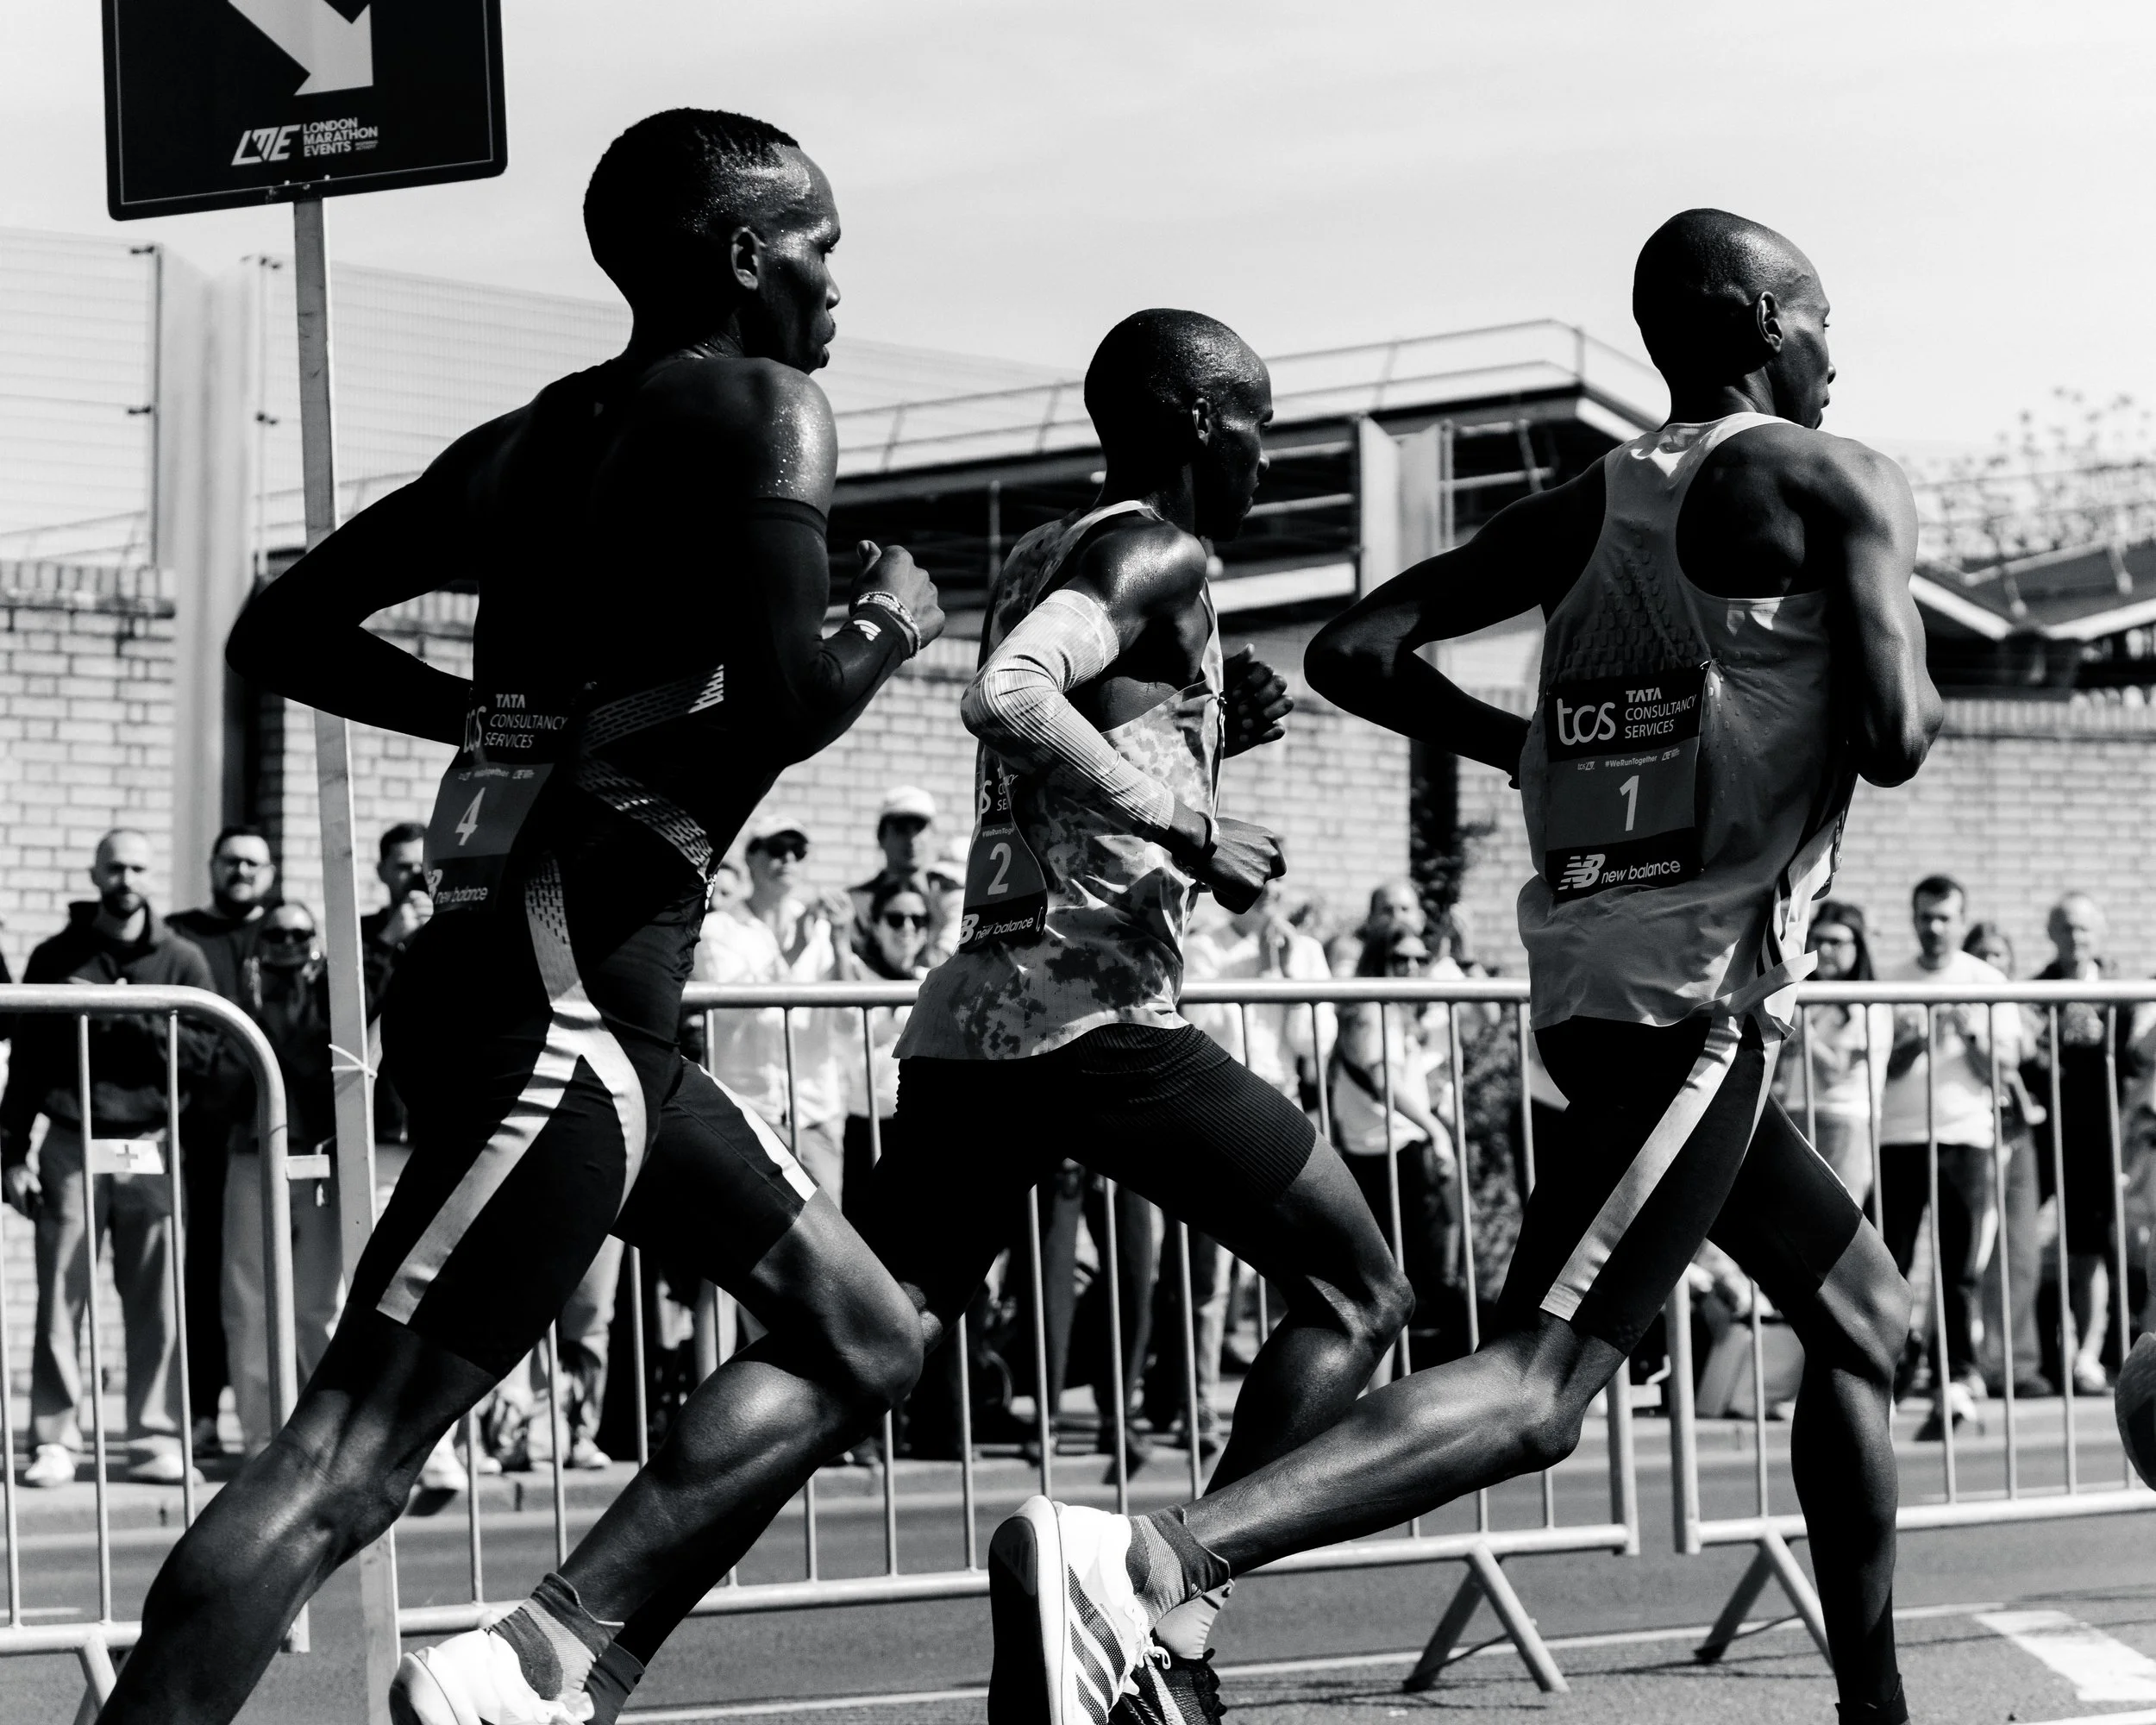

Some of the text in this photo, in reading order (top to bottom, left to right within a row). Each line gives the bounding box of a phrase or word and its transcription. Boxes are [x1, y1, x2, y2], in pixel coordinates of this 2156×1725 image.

[303, 116, 358, 135] LONDON
[304, 127, 379, 144] MARATHON
[304, 141, 351, 157] EVENTS
[495, 693, 526, 708] TATA
[1626, 687, 1663, 703] TATA
[1625, 694, 1697, 721] CONSULTANCY
[490, 713, 569, 731] CONSULTANCY
[1557, 698, 1616, 746] tcs
[1625, 718, 1674, 739] SERVICES
[484, 731, 535, 749] SERVICES
[1605, 755, 1658, 768] #WeRunTogether
[1619, 775, 1639, 831] 1
[454, 787, 486, 846] 4
[987, 842, 1012, 896] 2
[1601, 868, 1627, 884] new
[1628, 859, 1681, 881] balance
[451, 886, 488, 902] balance
[975, 925, 993, 941] new
[993, 917, 1034, 935] balance
